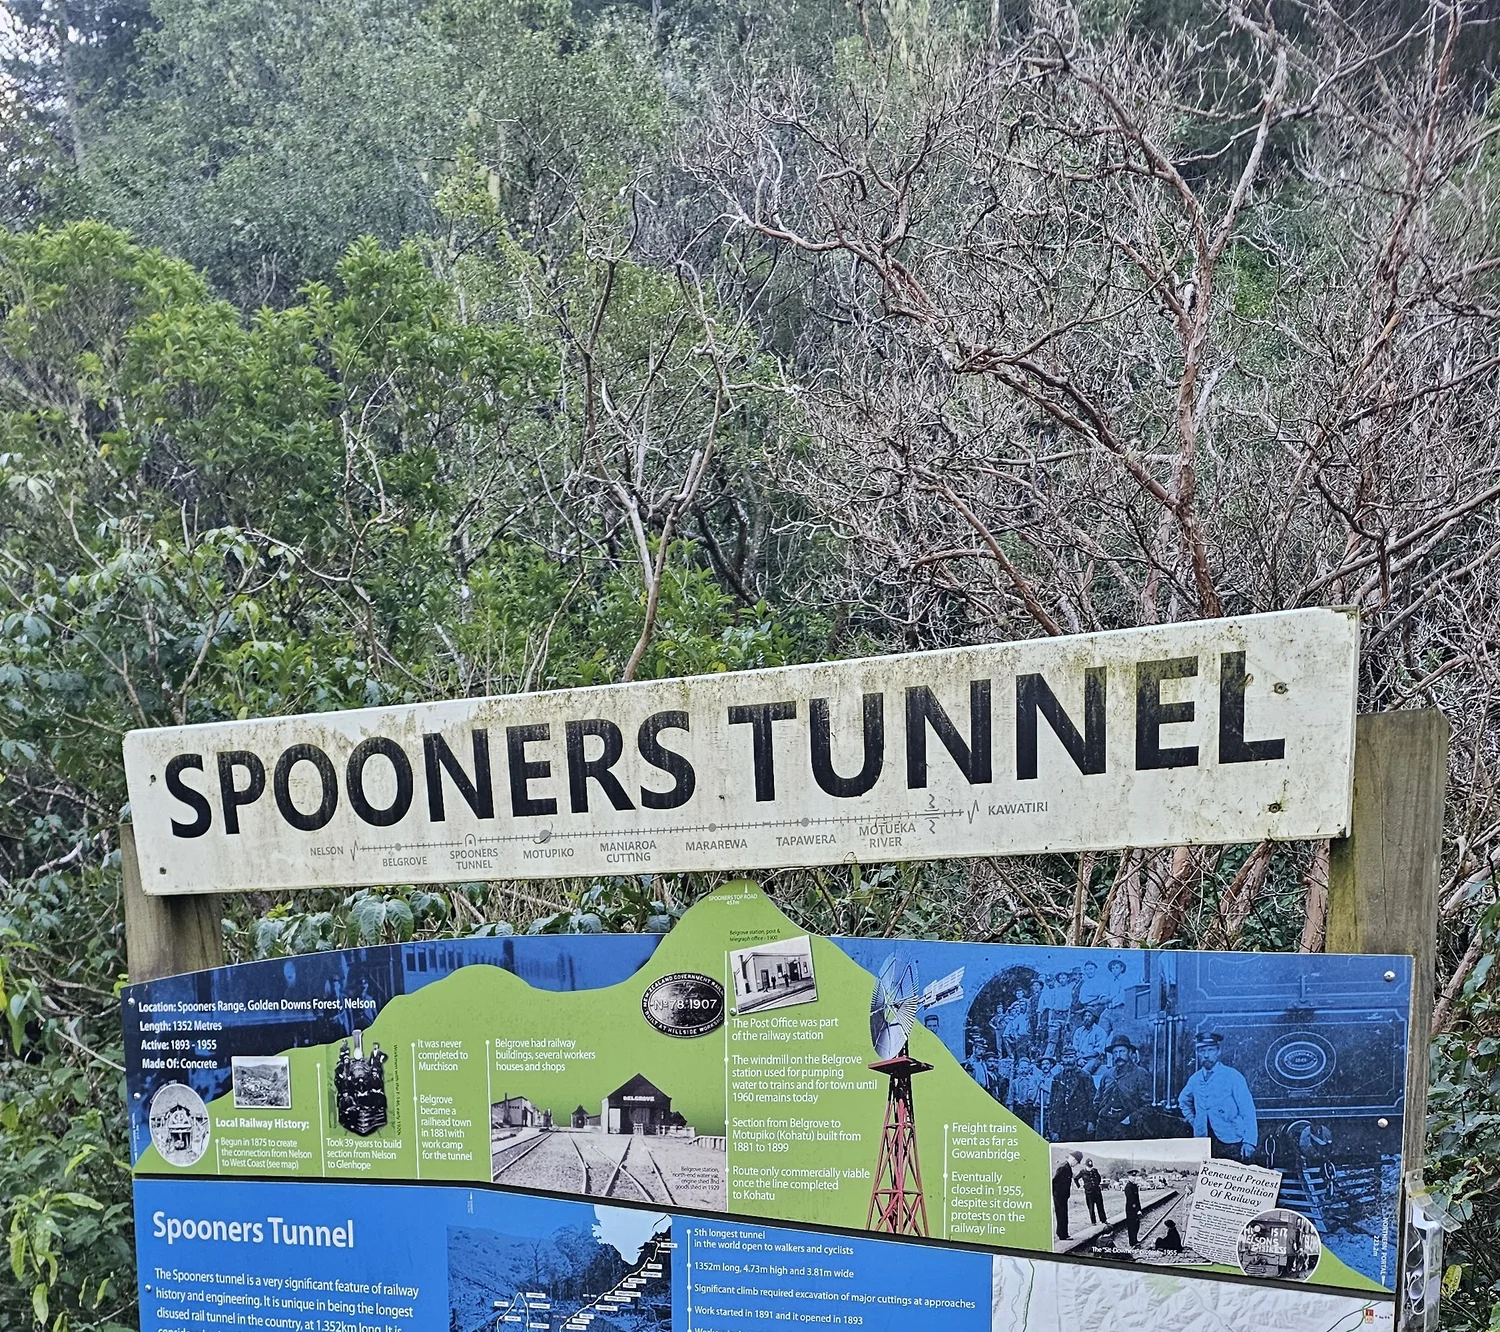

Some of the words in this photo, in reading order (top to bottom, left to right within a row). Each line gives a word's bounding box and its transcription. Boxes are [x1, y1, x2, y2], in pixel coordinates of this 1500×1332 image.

[163, 710, 697, 839] SPOONERS
[727, 650, 1285, 802] TUNNEL
[988, 801, 1048, 816] KAWATIRI
[858, 822, 916, 836] MOTUEKA
[600, 840, 657, 852] MANIAROA
[685, 839, 748, 851] MARAREWA
[776, 834, 836, 847] TAPAWERA
[869, 837, 902, 848] RIVER
[310, 845, 344, 857] NELSON
[450, 848, 498, 859] SPOONERS
[523, 848, 574, 859] MOTUPIKO
[382, 856, 427, 867] BELGROVE
[606, 852, 651, 863] CUTTING
[456, 860, 493, 870] TUNNEL
[138, 1002, 176, 1012] Location:
[178, 1001, 216, 1014] Spooners
[218, 1001, 246, 1014] Range,
[247, 999, 279, 1010] Golden
[280, 999, 311, 1010] Downs
[312, 998, 342, 1010] Forest,
[344, 997, 376, 1008] Nelson
[139, 1020, 171, 1033] Length:
[172, 1020, 192, 1030] 1352
[193, 1020, 222, 1030] Metres
[731, 1018, 748, 1028] The
[750, 1017, 769, 1028] Post
[770, 1017, 797, 1027] Office
[799, 1019, 817, 1027] was
[819, 1017, 838, 1028] part
[731, 1030, 741, 1040] of
[742, 1030, 757, 1040] the
[759, 1030, 791, 1042] railway
[792, 1030, 823, 1040] station
[140, 1039, 169, 1050] Active:
[170, 1039, 190, 1049] 1893
[196, 1039, 216, 1050] 1955
[495, 1038, 529, 1049] Belgrove
[530, 1038, 546, 1047] had
[547, 1038, 576, 1049] railway
[495, 1049, 533, 1060] buildings,
[534, 1049, 562, 1059] several
[563, 1049, 595, 1059] workers
[141, 1058, 165, 1068] Made
[166, 1058, 179, 1068] Of:
[180, 1058, 217, 1068] Concrete
[495, 1061, 523, 1071] houses
[524, 1061, 540, 1071] and
[541, 1061, 565, 1072] shops
[215, 1117, 237, 1127] Local
[239, 1117, 272, 1130] Railway
[274, 1118, 309, 1131] History:
[952, 1122, 987, 1134] Freight
[988, 1122, 1017, 1132] trains
[951, 1136, 977, 1145] went
[978, 1137, 989, 1145] as
[991, 1136, 1005, 1146] far
[1006, 1138, 1018, 1146] as
[951, 1148, 1020, 1161] Gowanbridge
[1201, 1166, 1243, 1182] Renewed
[1244, 1174, 1279, 1189] Protest
[1200, 1177, 1222, 1188] Over
[1224, 1181, 1274, 1199] Demolition
[1210, 1189, 1223, 1198] Of
[1224, 1192, 1261, 1207] Railway
[152, 1211, 263, 1244] Spooners
[267, 1216, 353, 1247] Tunnel
[693, 1228, 707, 1236] 5th
[708, 1228, 737, 1239] longest
[739, 1230, 765, 1239] tunnel
[694, 1239, 701, 1247] in
[702, 1239, 716, 1248] the
[717, 1240, 740, 1249] world
[741, 1242, 762, 1251] open
[774, 1243, 804, 1252] walkers
[806, 1244, 822, 1253] and
[823, 1245, 853, 1255] cyclists
[694, 1261, 720, 1270] 1352m
[722, 1262, 741, 1273] long,
[742, 1264, 767, 1273] 4.73m
[769, 1265, 787, 1276] high
[789, 1266, 805, 1275] and
[806, 1267, 831, 1276] 3.81m
[833, 1268, 854, 1278] wide
[154, 1267, 171, 1279] The
[172, 1268, 214, 1282] Spooners
[215, 1273, 244, 1284] tunnel
[246, 1273, 254, 1285] is
[255, 1277, 261, 1285] a
[262, 1277, 283, 1290] very
[284, 1276, 333, 1291] significant
[334, 1279, 369, 1293] feature
[371, 1282, 382, 1294] of
[383, 1283, 419, 1299] railway
